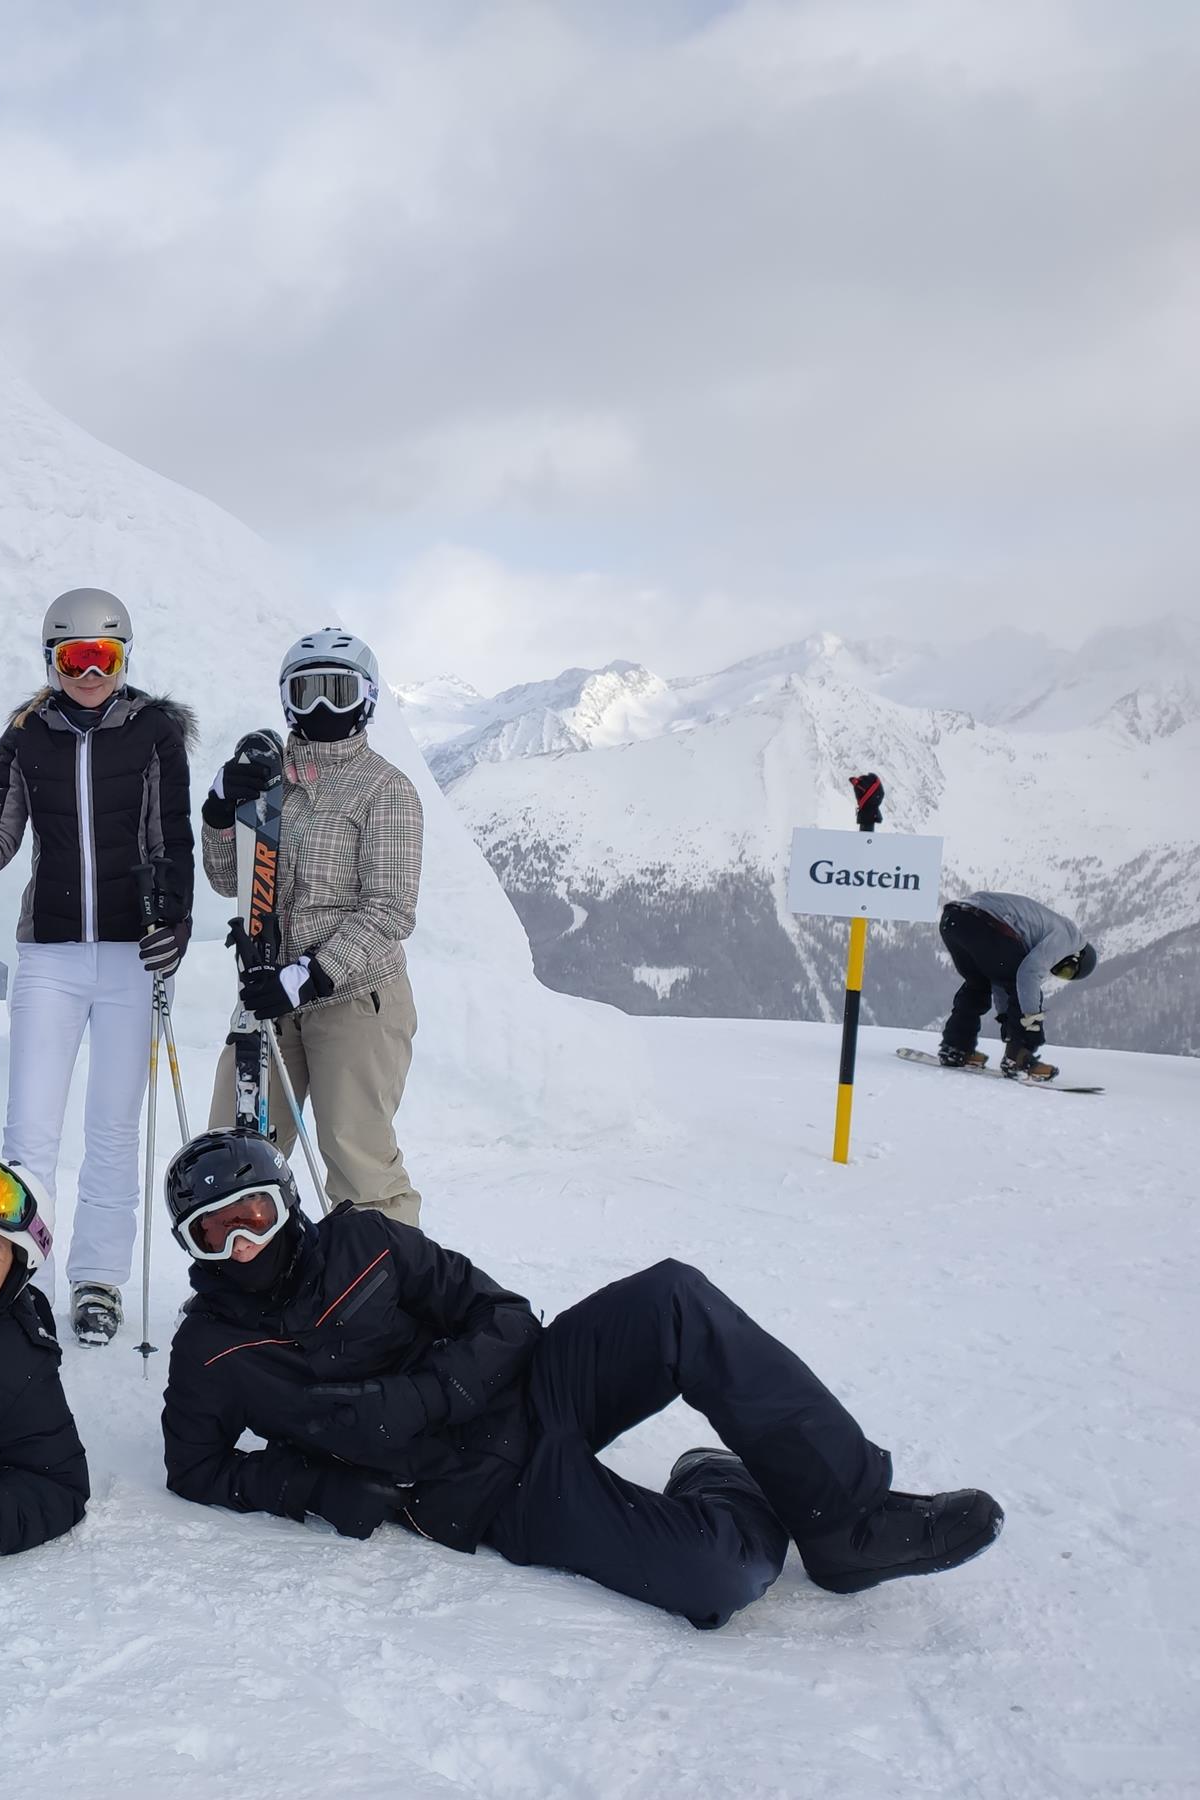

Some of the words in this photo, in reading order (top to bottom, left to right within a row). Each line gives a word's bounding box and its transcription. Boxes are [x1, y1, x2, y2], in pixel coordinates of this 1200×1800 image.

[809, 859, 921, 890] Gastein
[143, 896, 152, 915] LEKI
[157, 980, 170, 1016] LEKI
